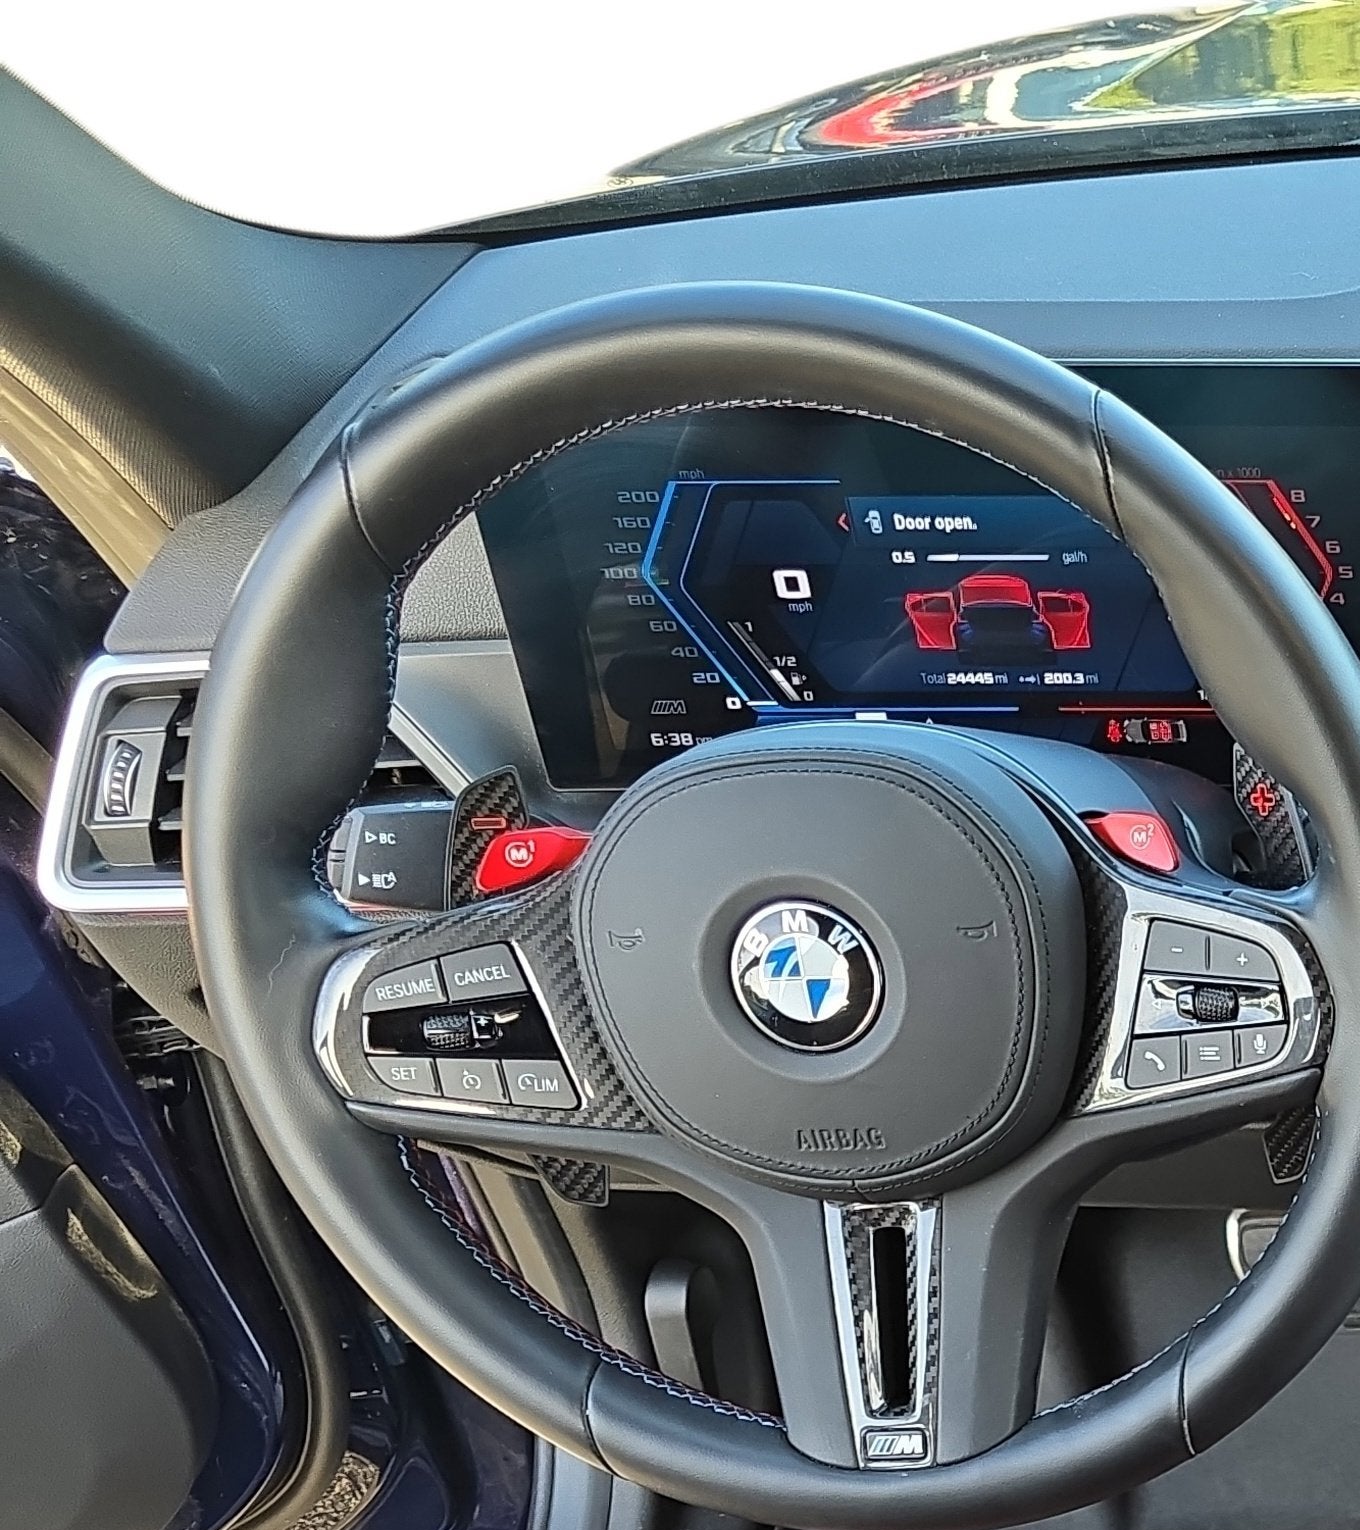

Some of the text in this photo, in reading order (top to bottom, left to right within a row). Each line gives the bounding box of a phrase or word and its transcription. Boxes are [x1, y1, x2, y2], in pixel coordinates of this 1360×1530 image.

[679, 468, 705, 480] mph
[1237, 467, 1261, 479] 1000
[617, 491, 660, 503] 200
[1290, 489, 1306, 503] 8
[612, 516, 651, 529] 160
[893, 512, 931, 531] Door
[1305, 515, 1321, 528] 7
[603, 542, 642, 554] 120
[1325, 541, 1341, 554] 6
[891, 551, 1088, 565] 0.5 gal/h
[600, 567, 639, 579] 100
[1338, 565, 1354, 579] 5
[772, 569, 812, 599] 0
[627, 594, 656, 606] 80
[1329, 592, 1345, 605] 4
[788, 601, 813, 613] mph
[649, 620, 678, 632] 60
[744, 621, 753, 632] 1
[671, 646, 699, 658] 40
[773, 655, 797, 667] 1/2
[692, 672, 721, 684] 20
[920, 672, 1009, 685] Total 24445 mi
[1044, 672, 1099, 685] 200.3 mi
[726, 696, 742, 709] 0
[803, 690, 814, 702] 0
[650, 732, 694, 747] 6:38
[378, 832, 397, 845] BC
[743, 909, 860, 958] BMW
[454, 964, 511, 986] CANCEL
[375, 978, 436, 1001] RESUME
[391, 1067, 417, 1081] SET
[534, 1078, 559, 1092] LIM
[797, 1127, 887, 1152] AIRBAG
